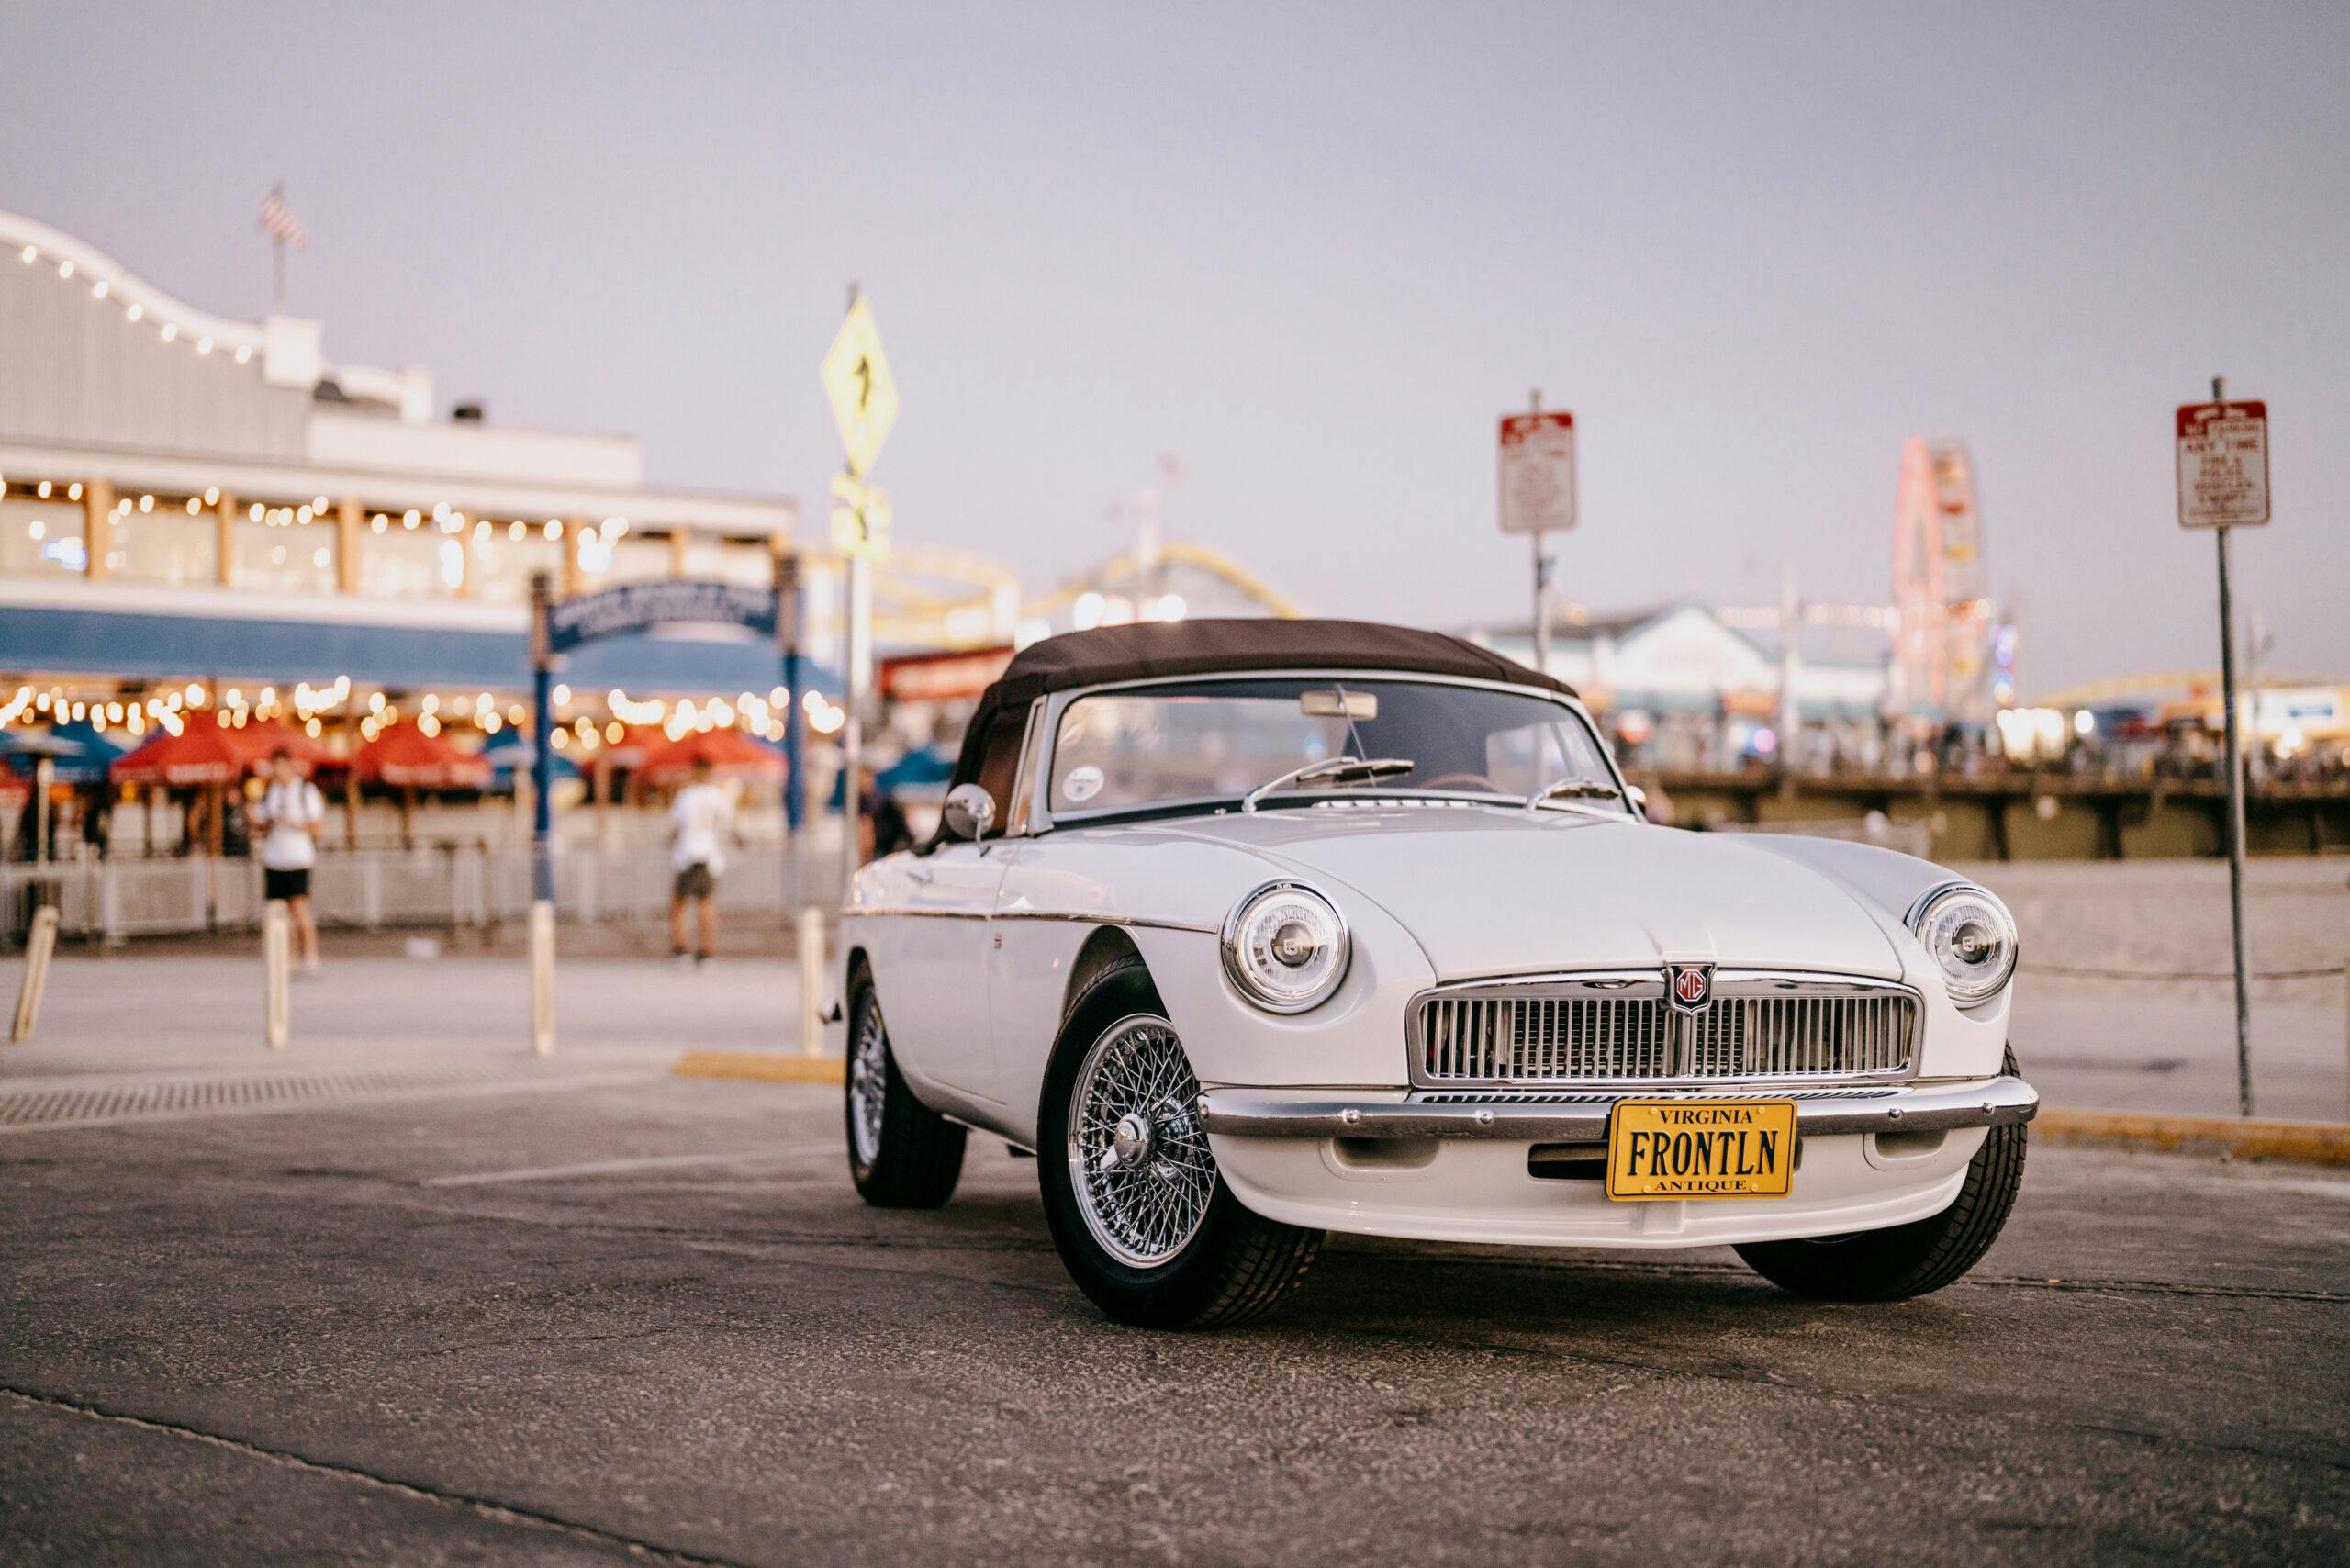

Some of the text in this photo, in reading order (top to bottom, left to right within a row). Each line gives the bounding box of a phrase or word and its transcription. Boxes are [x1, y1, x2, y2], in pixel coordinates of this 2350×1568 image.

[1679, 972, 1704, 998] MG
[1660, 1109, 1752, 1125] VIRGINIA
[1628, 1130, 1779, 1176] FRONTLN
[1654, 1180, 1747, 1192] ANTIQUE
